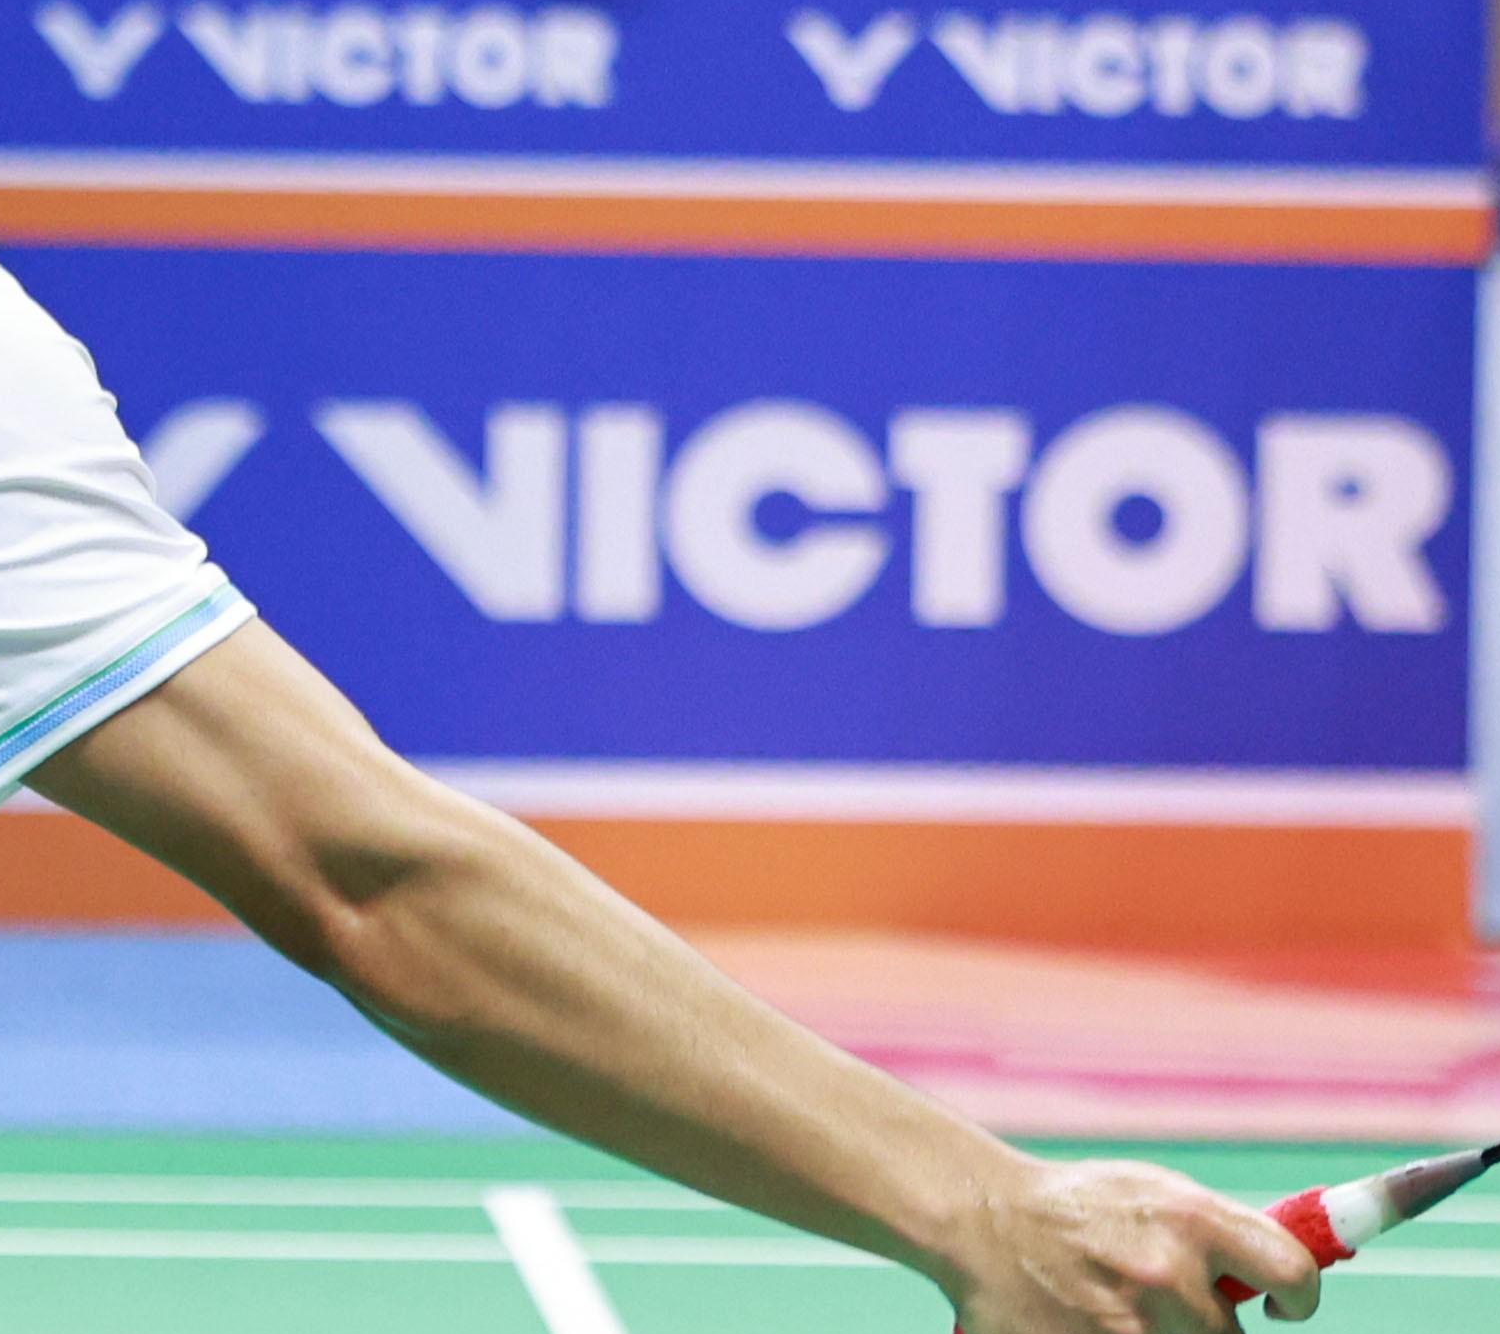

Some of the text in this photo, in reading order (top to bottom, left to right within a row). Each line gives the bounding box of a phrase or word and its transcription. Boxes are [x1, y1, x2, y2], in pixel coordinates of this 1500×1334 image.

[182, 3, 616, 107] VICTOR
[932, 13, 1368, 118] VICTOR
[318, 400, 1455, 635] VICTOR
